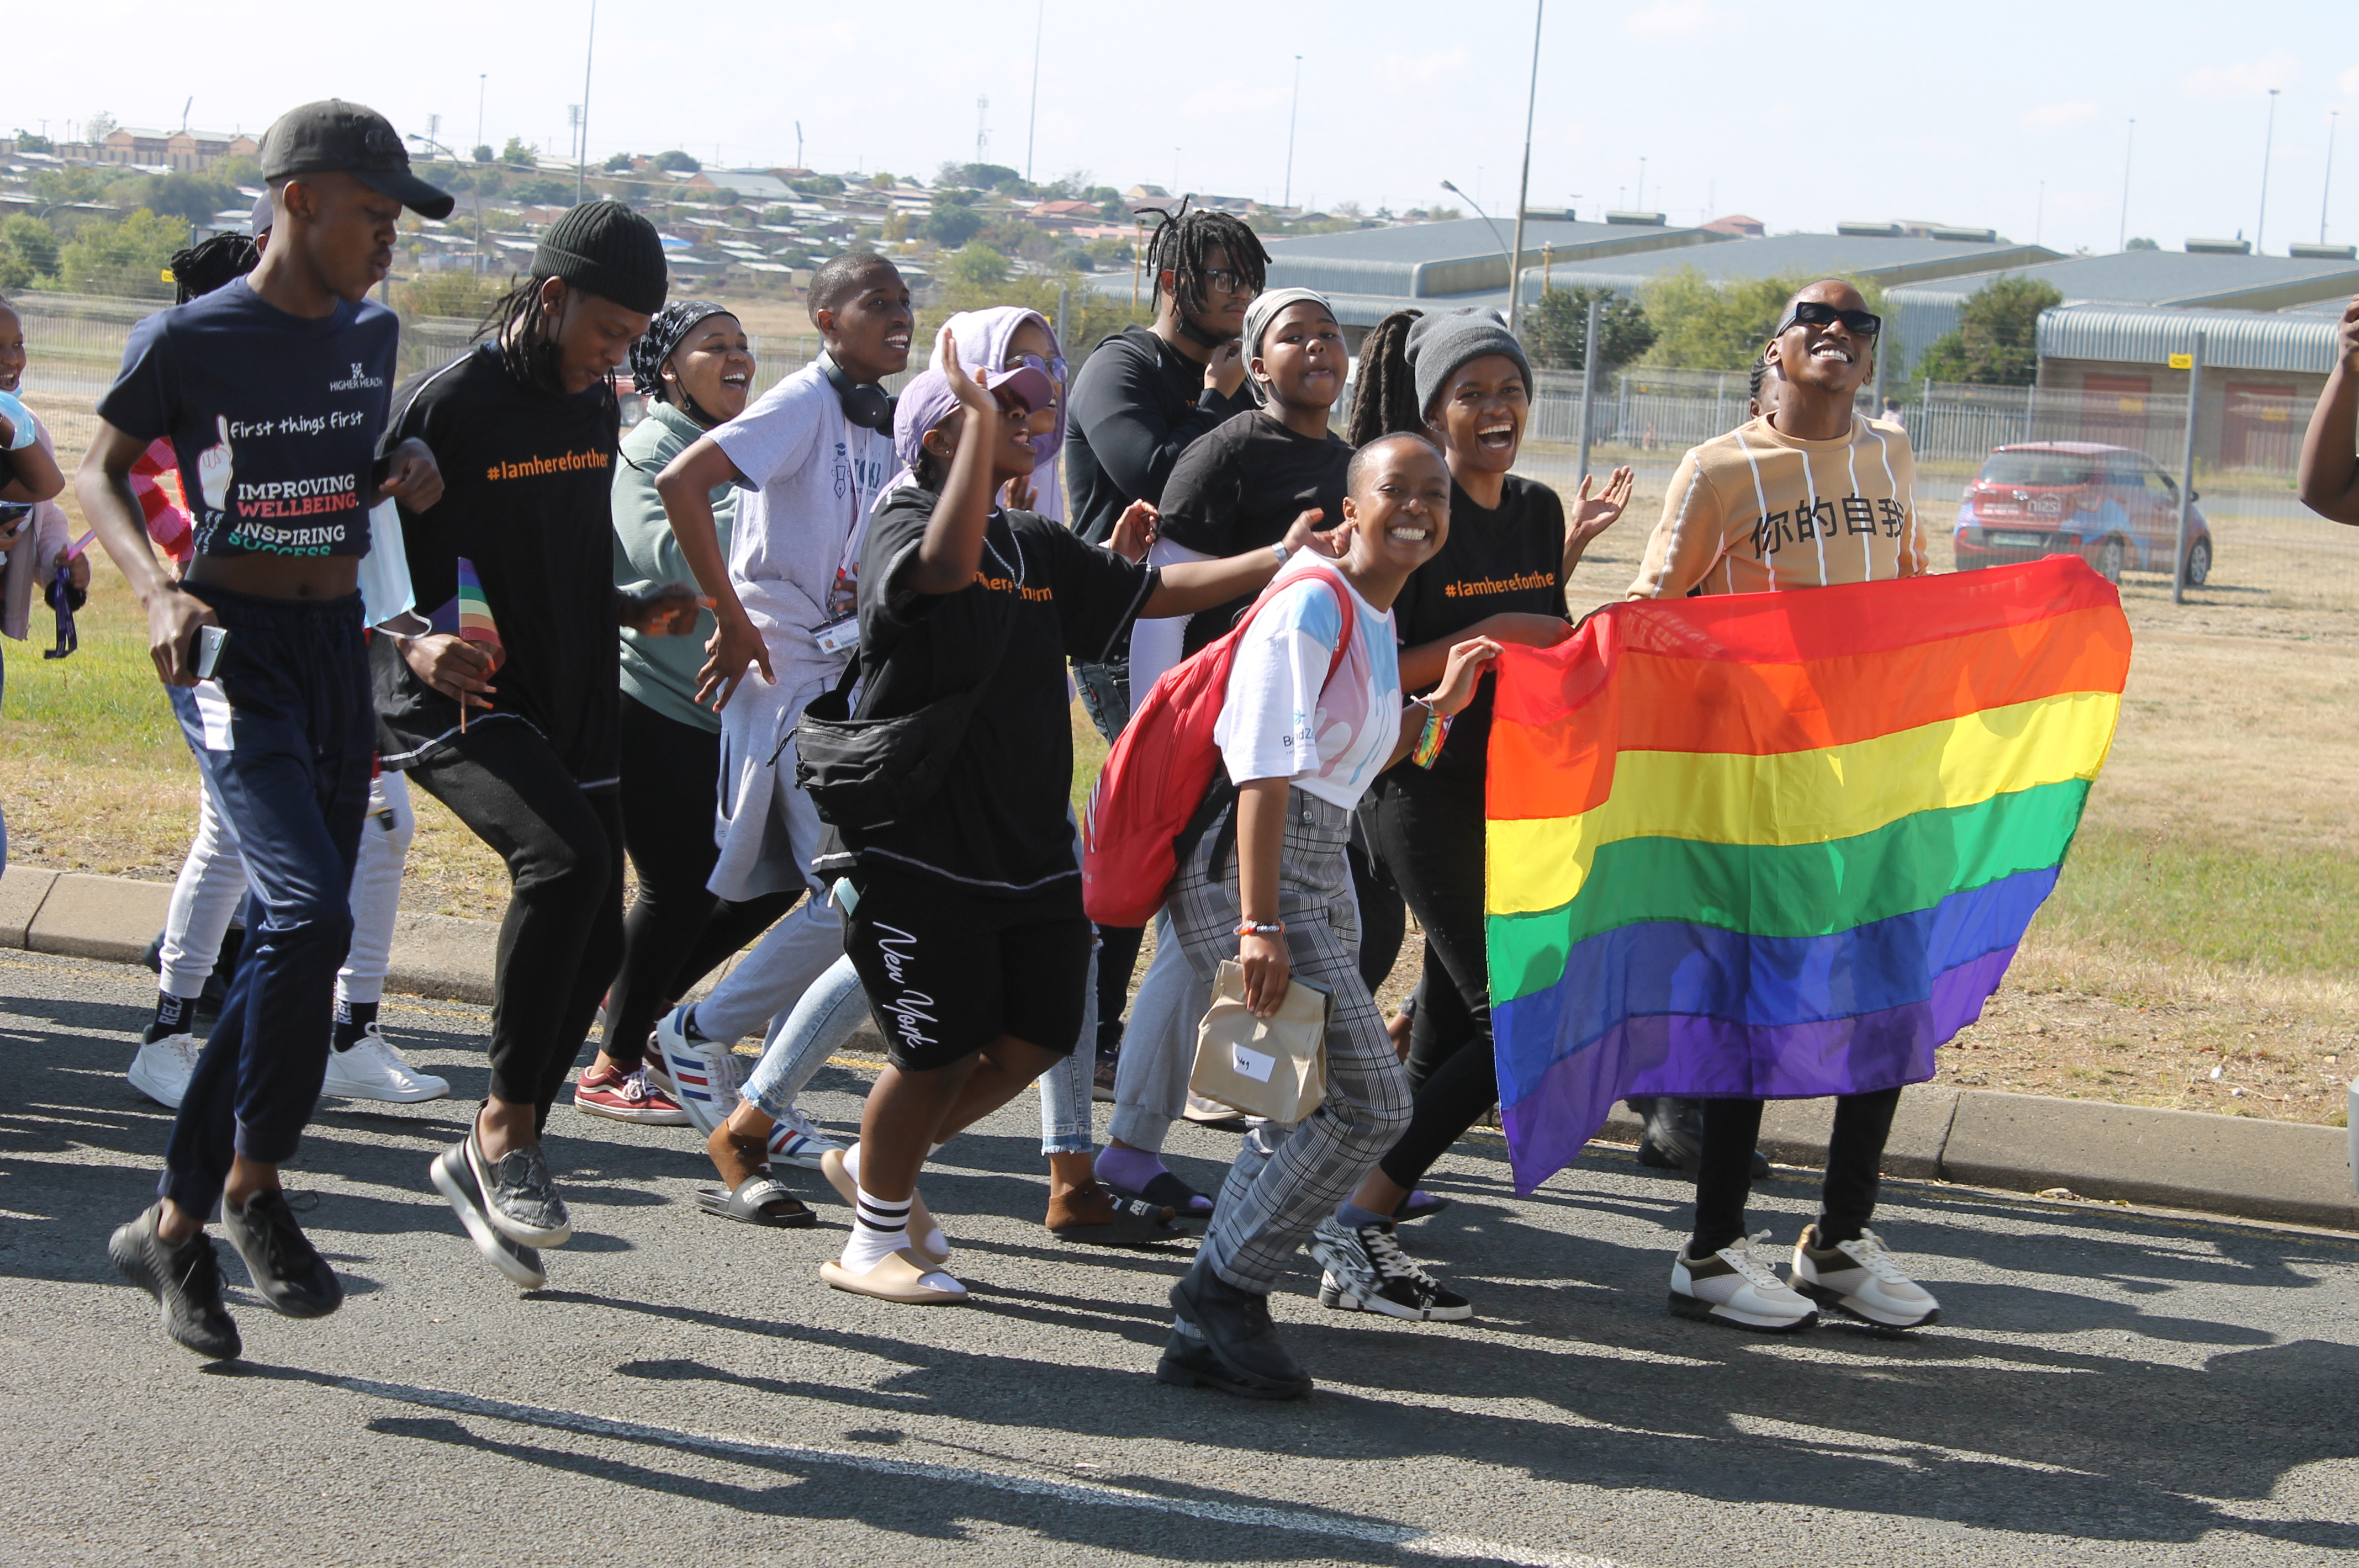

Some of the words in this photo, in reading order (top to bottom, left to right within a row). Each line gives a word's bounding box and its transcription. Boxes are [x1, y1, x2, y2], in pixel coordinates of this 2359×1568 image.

[330, 378, 359, 391] HIGHER
[359, 377, 383, 388] HEALTH
[279, 415, 325, 435] things
[238, 474, 355, 500] IMPROVING
[236, 491, 359, 517] WELLBEING.
[234, 522, 345, 545] INSPIRING
[872, 921, 917, 984] New
[882, 990, 939, 1048] York
